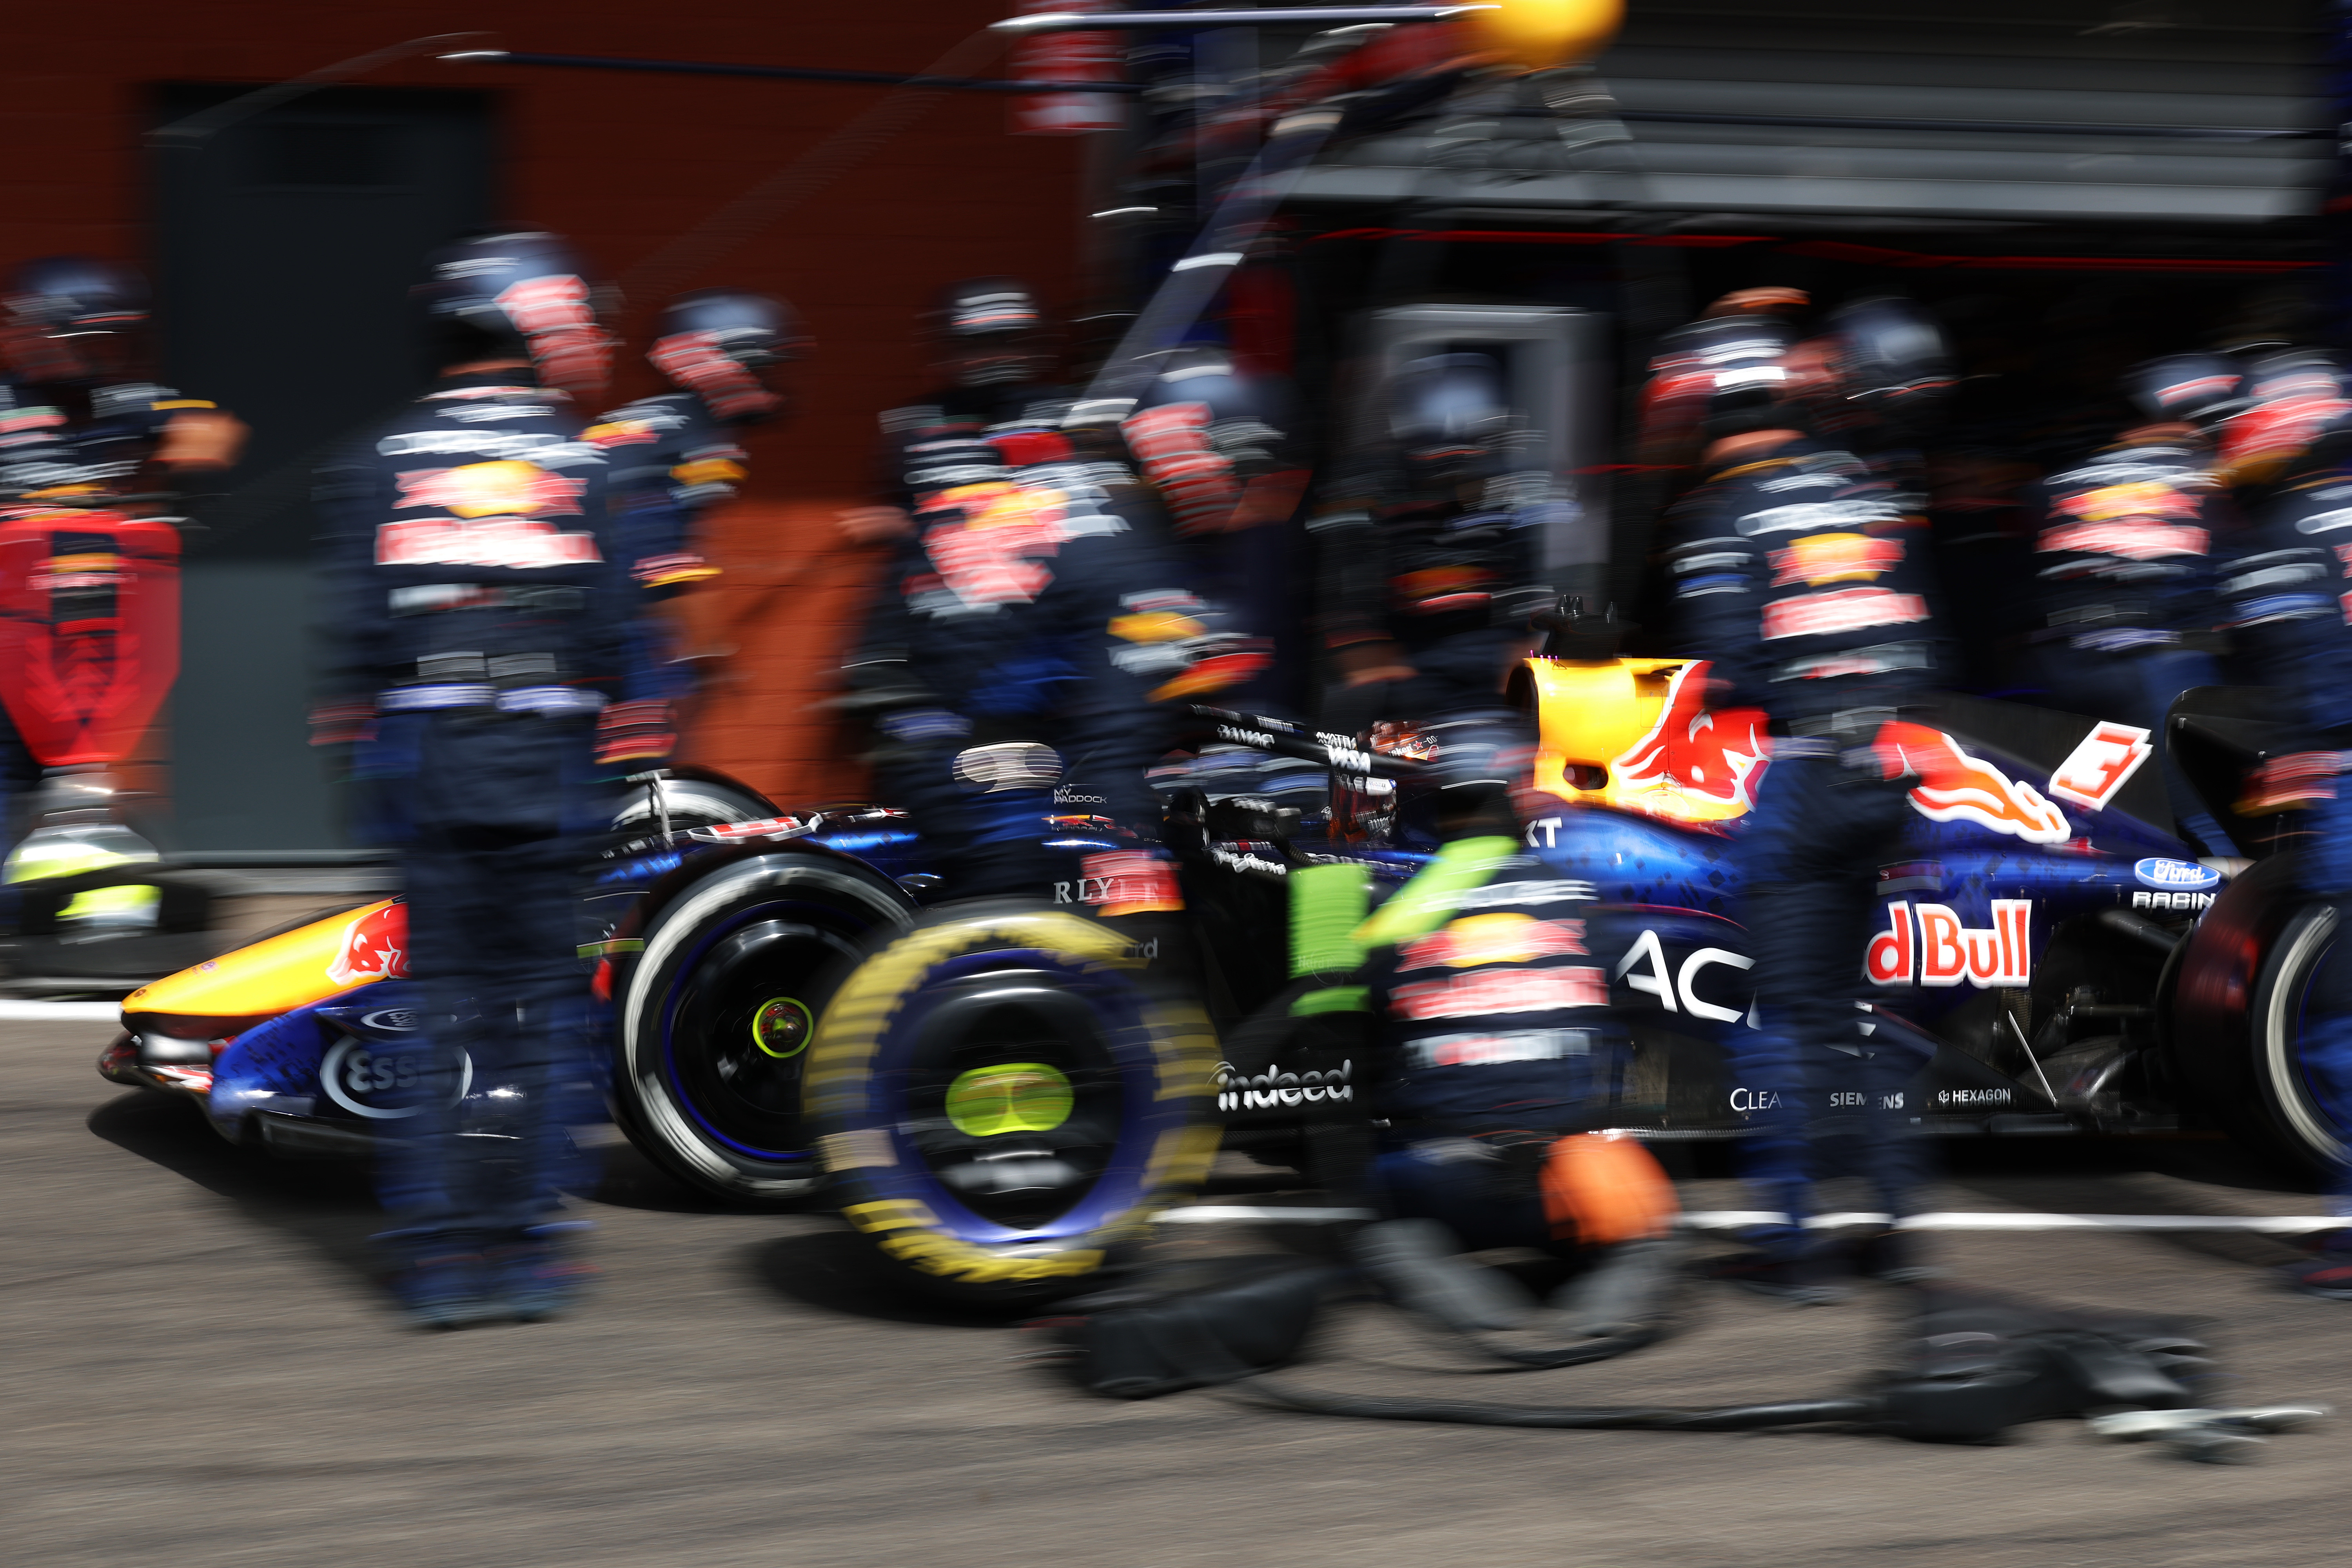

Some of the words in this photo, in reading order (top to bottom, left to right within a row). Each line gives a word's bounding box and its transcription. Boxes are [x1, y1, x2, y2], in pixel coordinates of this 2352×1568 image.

[1316, 731, 1357, 750] AVATRA
[1324, 744, 1371, 774] VISA
[1054, 788, 1072, 797] MY
[1054, 795, 1107, 805] PADDOCK
[2154, 859, 2206, 883] Ford
[2132, 891, 2216, 910] RACIN
[1915, 898, 2033, 989] Bull
[1208, 1059, 1354, 1112] indeed
[1730, 1088, 1782, 1112] CLEA
[1953, 1088, 2011, 1106] HEXAGON
